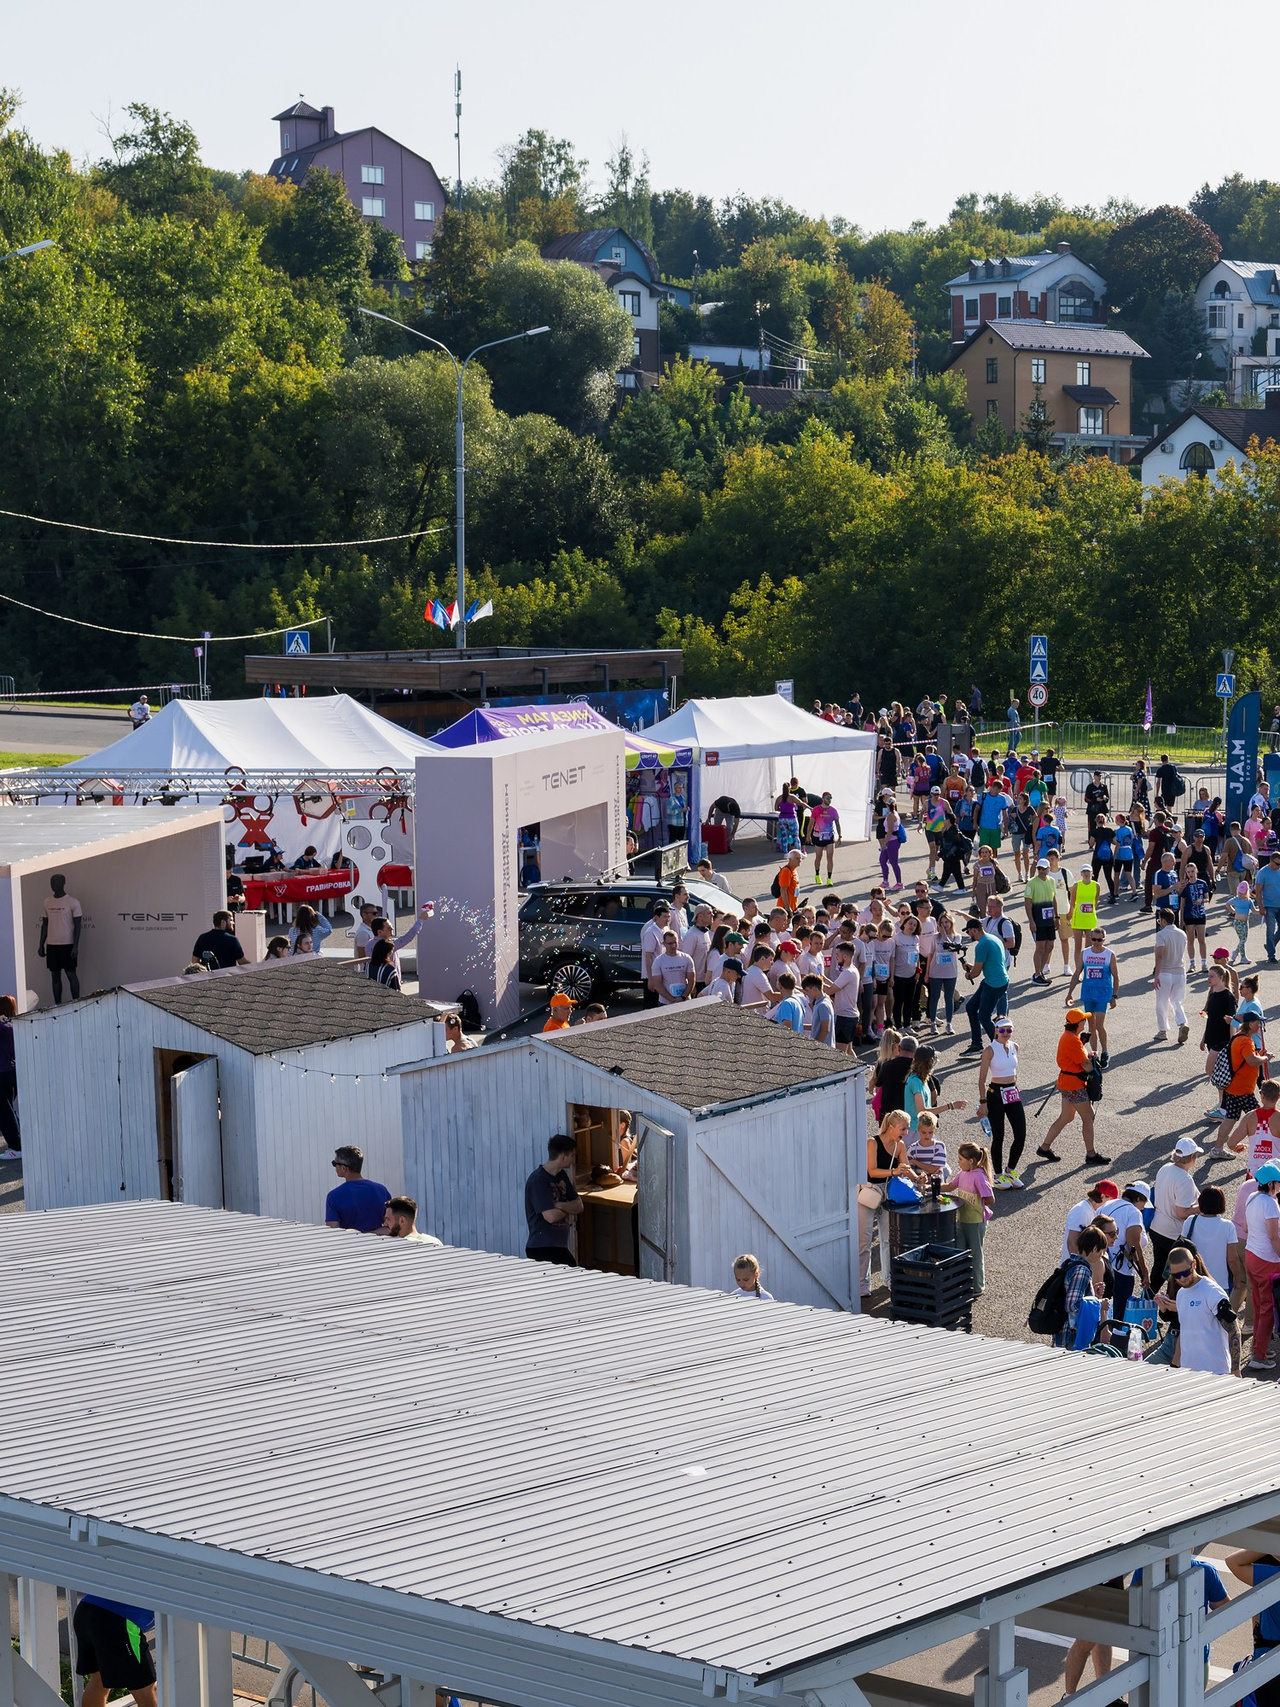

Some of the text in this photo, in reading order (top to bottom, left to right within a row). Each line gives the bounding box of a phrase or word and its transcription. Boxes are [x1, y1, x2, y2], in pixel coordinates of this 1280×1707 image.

[1032, 690, 1044, 700] 40
[517, 709, 593, 724] МАГАЗИН
[1230, 739, 1245, 795] J.A.M
[542, 765, 586, 791] TENET
[306, 881, 352, 893] ГРАВИРОВКА
[118, 913, 189, 922] TENET
[600, 943, 642, 952] TENE
